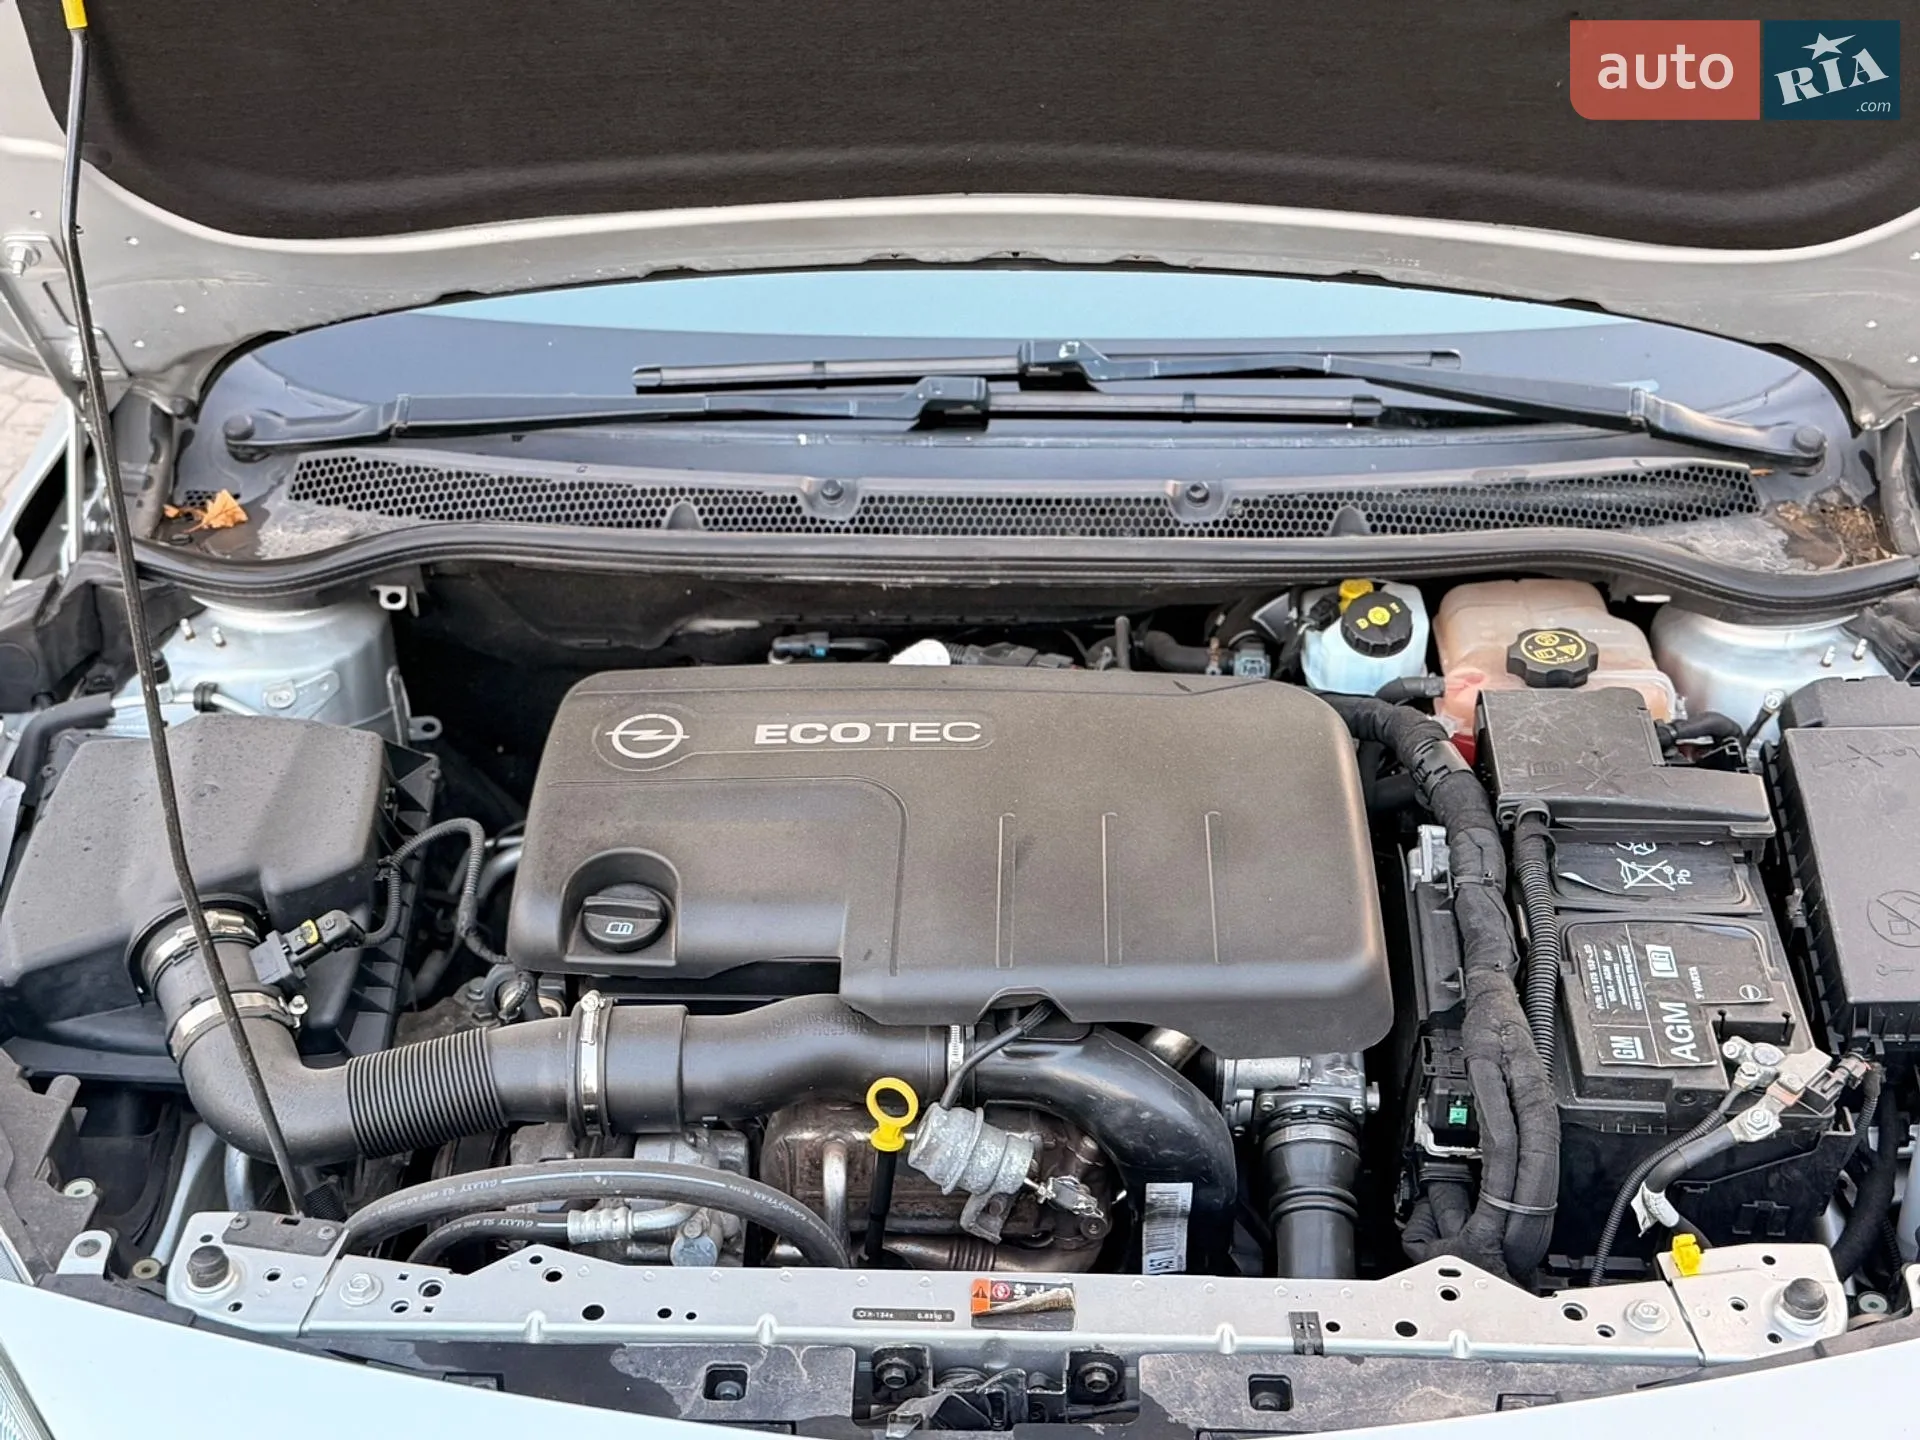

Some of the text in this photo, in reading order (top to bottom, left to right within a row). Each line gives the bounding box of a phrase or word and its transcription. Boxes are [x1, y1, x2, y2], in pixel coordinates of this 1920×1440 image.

[754, 721, 982, 745] ECOTEC
[1676, 868, 1694, 885] Pb
[1658, 1001, 1700, 1063] AGM
[1610, 1035, 1637, 1059] GM
